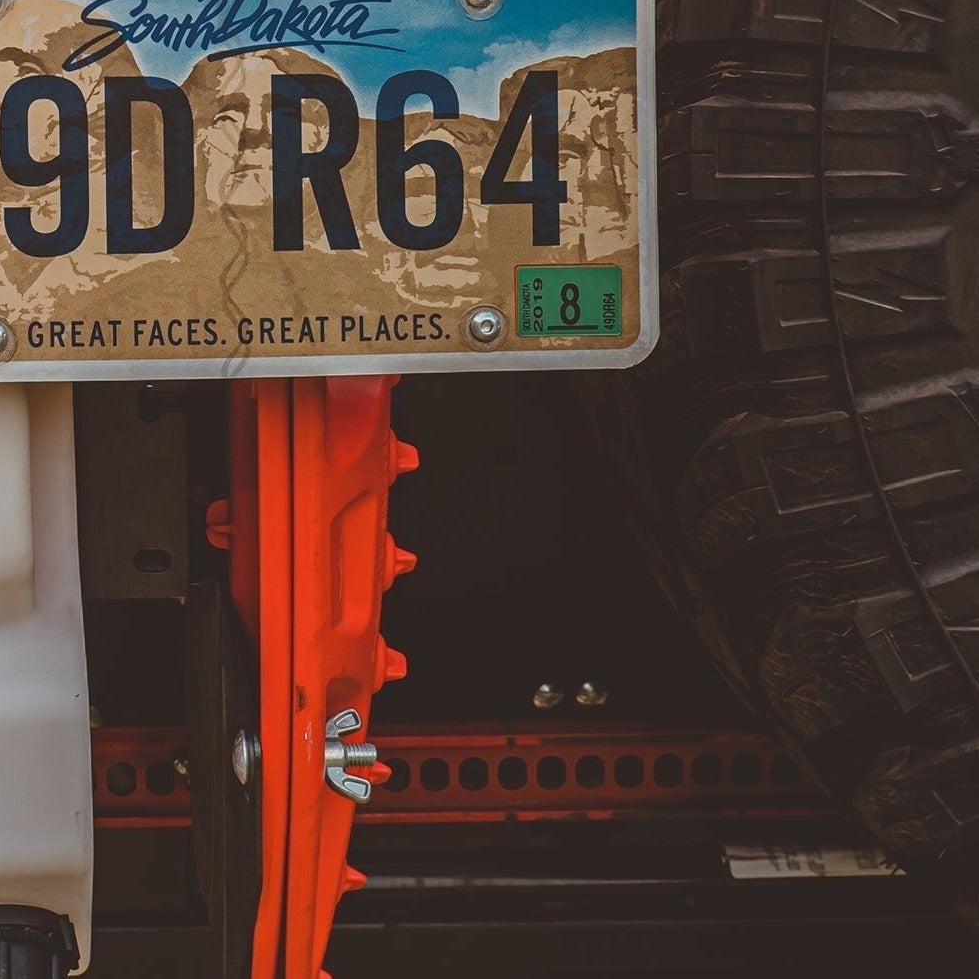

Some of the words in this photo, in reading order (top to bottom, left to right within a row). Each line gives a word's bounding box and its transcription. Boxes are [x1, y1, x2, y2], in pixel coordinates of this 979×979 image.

[270, 69, 568, 252] R64
[522, 309, 531, 332] SOUTH
[533, 278, 544, 332] 2019
[560, 282, 581, 326] 8
[603, 292, 616, 330] 49DR64
[27, 320, 122, 348] GREAT
[133, 318, 227, 347] FACES.
[237, 316, 329, 344] GREAT
[340, 313, 451, 342] PLACES.
